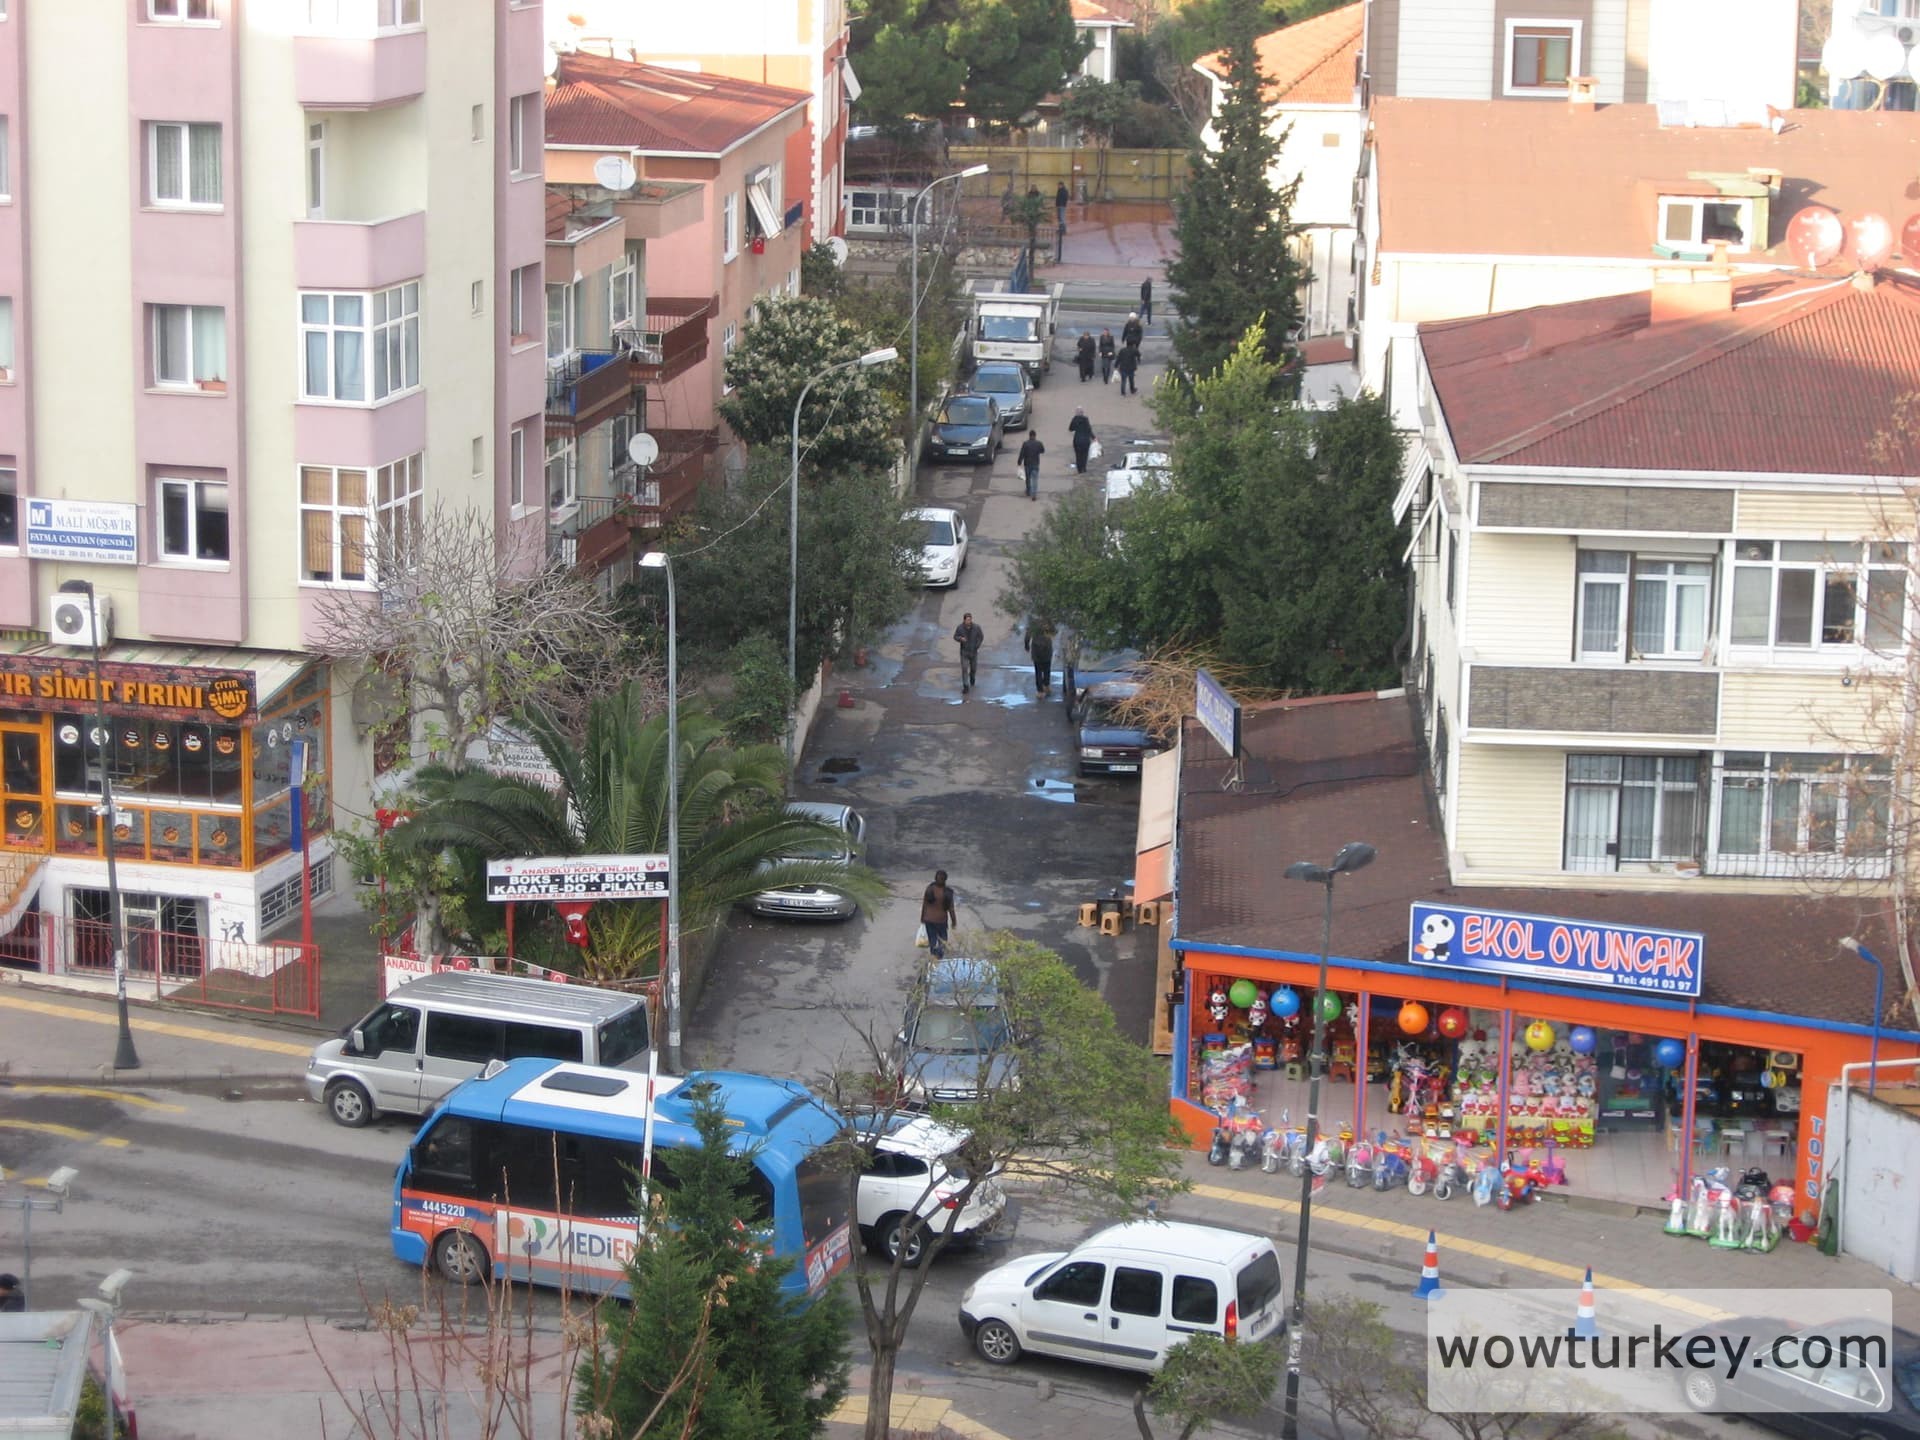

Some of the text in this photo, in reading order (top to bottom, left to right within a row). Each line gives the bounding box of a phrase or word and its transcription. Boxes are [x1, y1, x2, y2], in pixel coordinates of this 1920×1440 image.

[30, 532, 57, 543] FATMA
[59, 534, 96, 545] CANDAN
[122, 681, 204, 709] FIRINI
[509, 874, 551, 886] BOKS
[604, 871, 647, 883] BOKS
[521, 866, 571, 875] ANADOLU
[574, 865, 640, 874] KAPLANLARI
[493, 883, 587, 896] KARATE-DO
[1463, 915, 1696, 979] EKOL OYUNCAK
[385, 957, 426, 974] ANADOLU
[1617, 974, 1692, 991] Tel: 491 03 97
[1805, 1114, 1824, 1198] TOYS
[422, 1200, 466, 1217] 4445220
